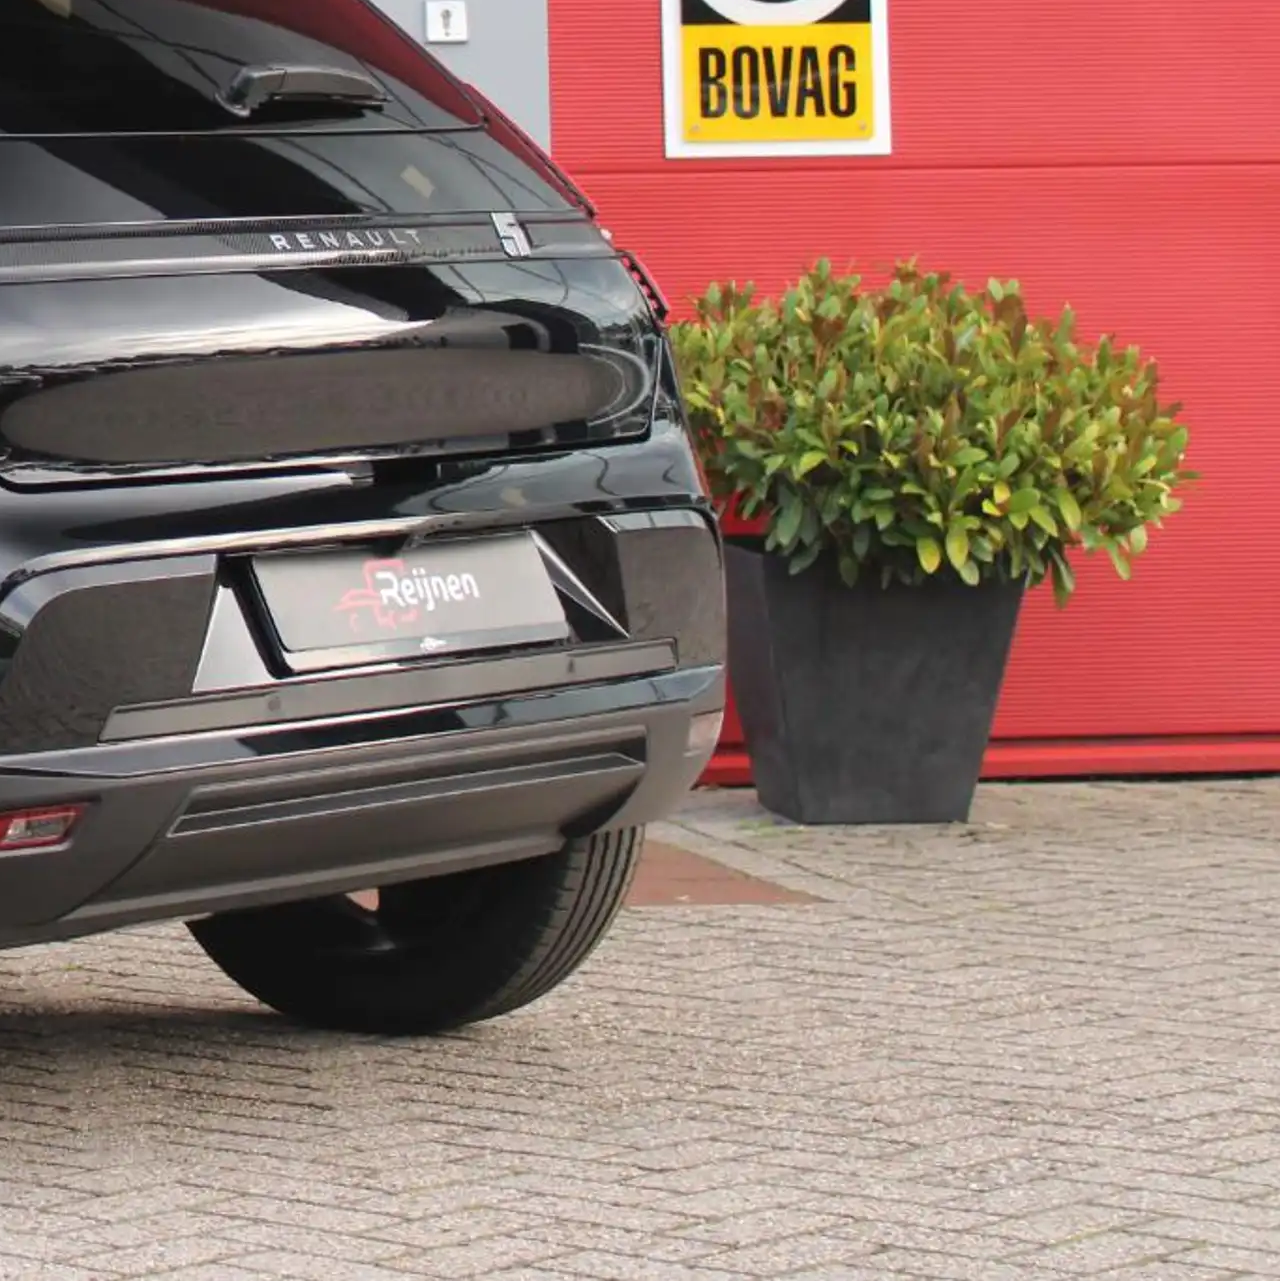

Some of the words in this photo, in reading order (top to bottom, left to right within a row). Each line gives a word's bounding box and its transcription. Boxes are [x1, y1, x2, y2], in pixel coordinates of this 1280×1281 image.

[698, 44, 857, 119] BOVAG
[269, 229, 421, 251] RENAULT
[491, 212, 531, 258] 5
[375, 568, 481, 612] Reijnen
